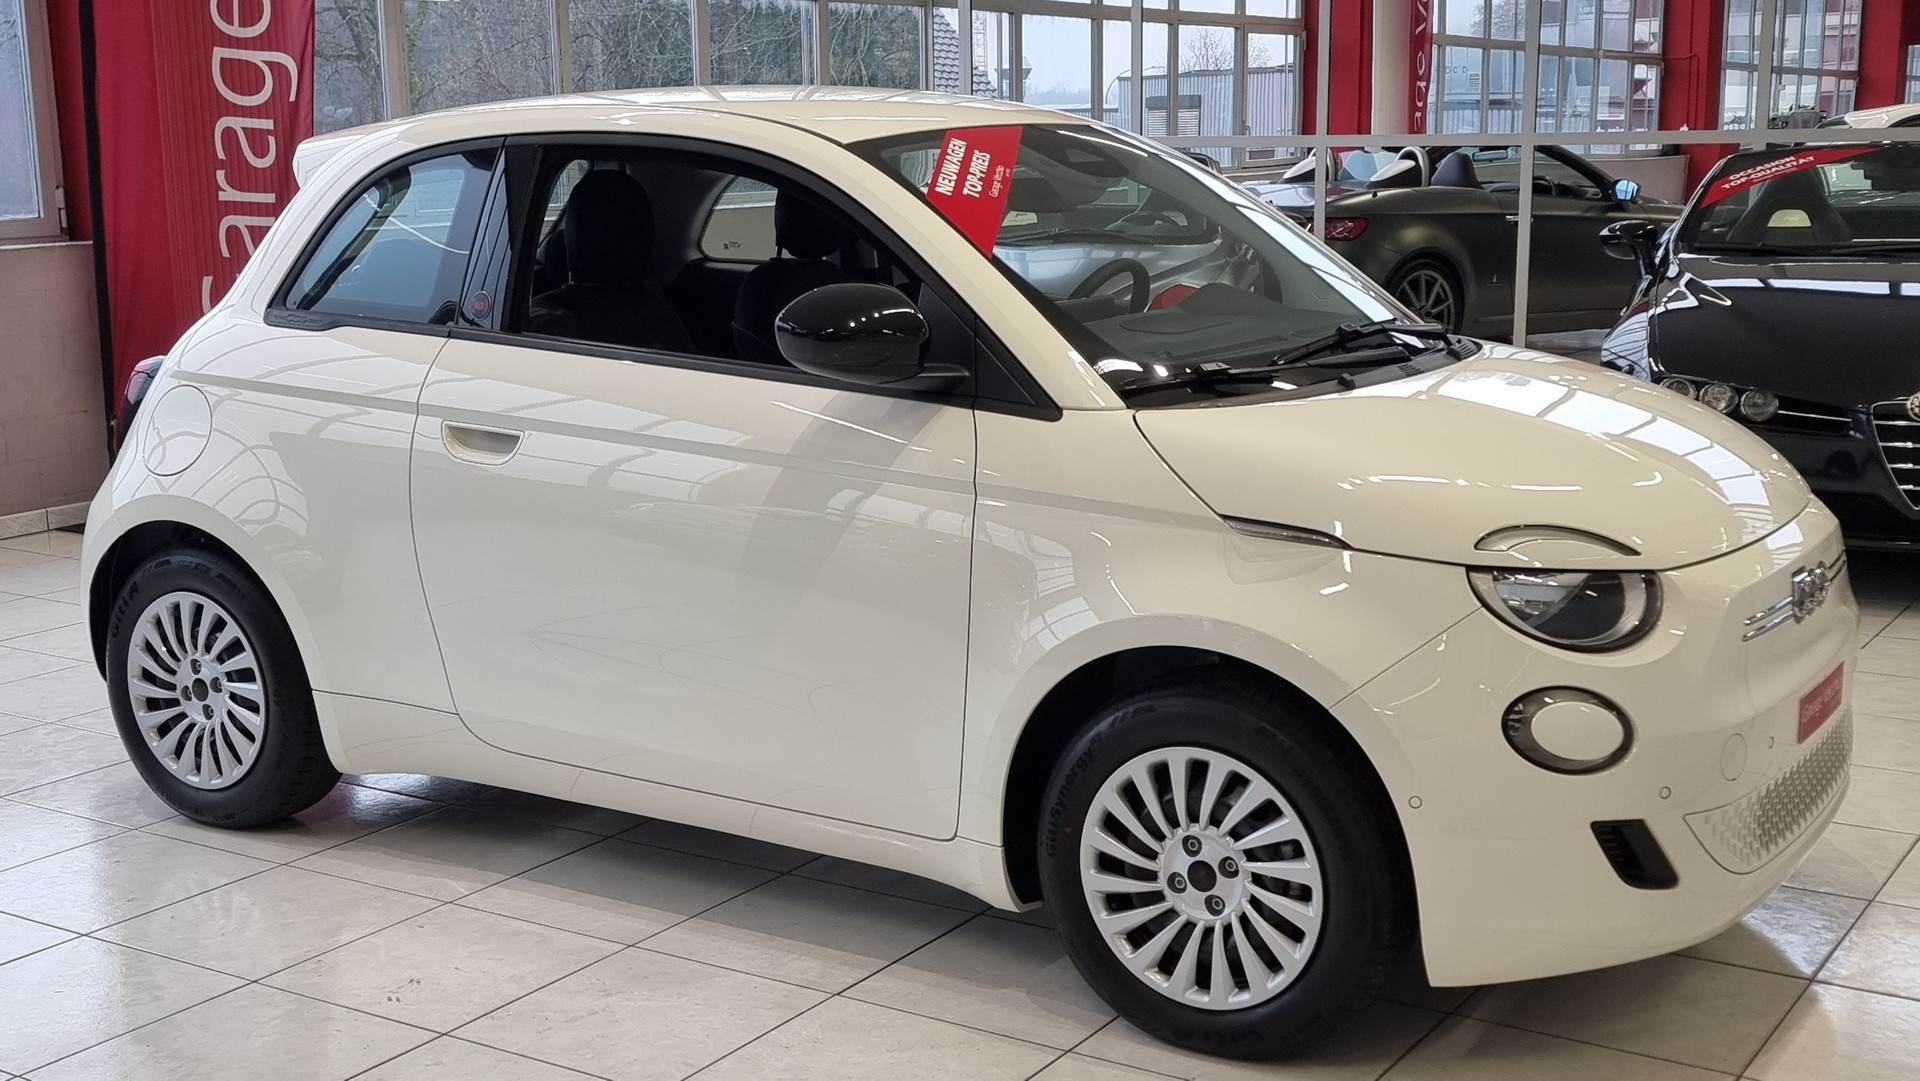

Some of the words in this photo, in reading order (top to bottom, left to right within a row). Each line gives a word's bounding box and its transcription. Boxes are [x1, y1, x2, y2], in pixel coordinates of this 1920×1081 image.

[935, 138, 967, 196] NEUWAGEN
[963, 150, 990, 198] TOP-PREIS
[1729, 156, 1796, 181] OCCASION
